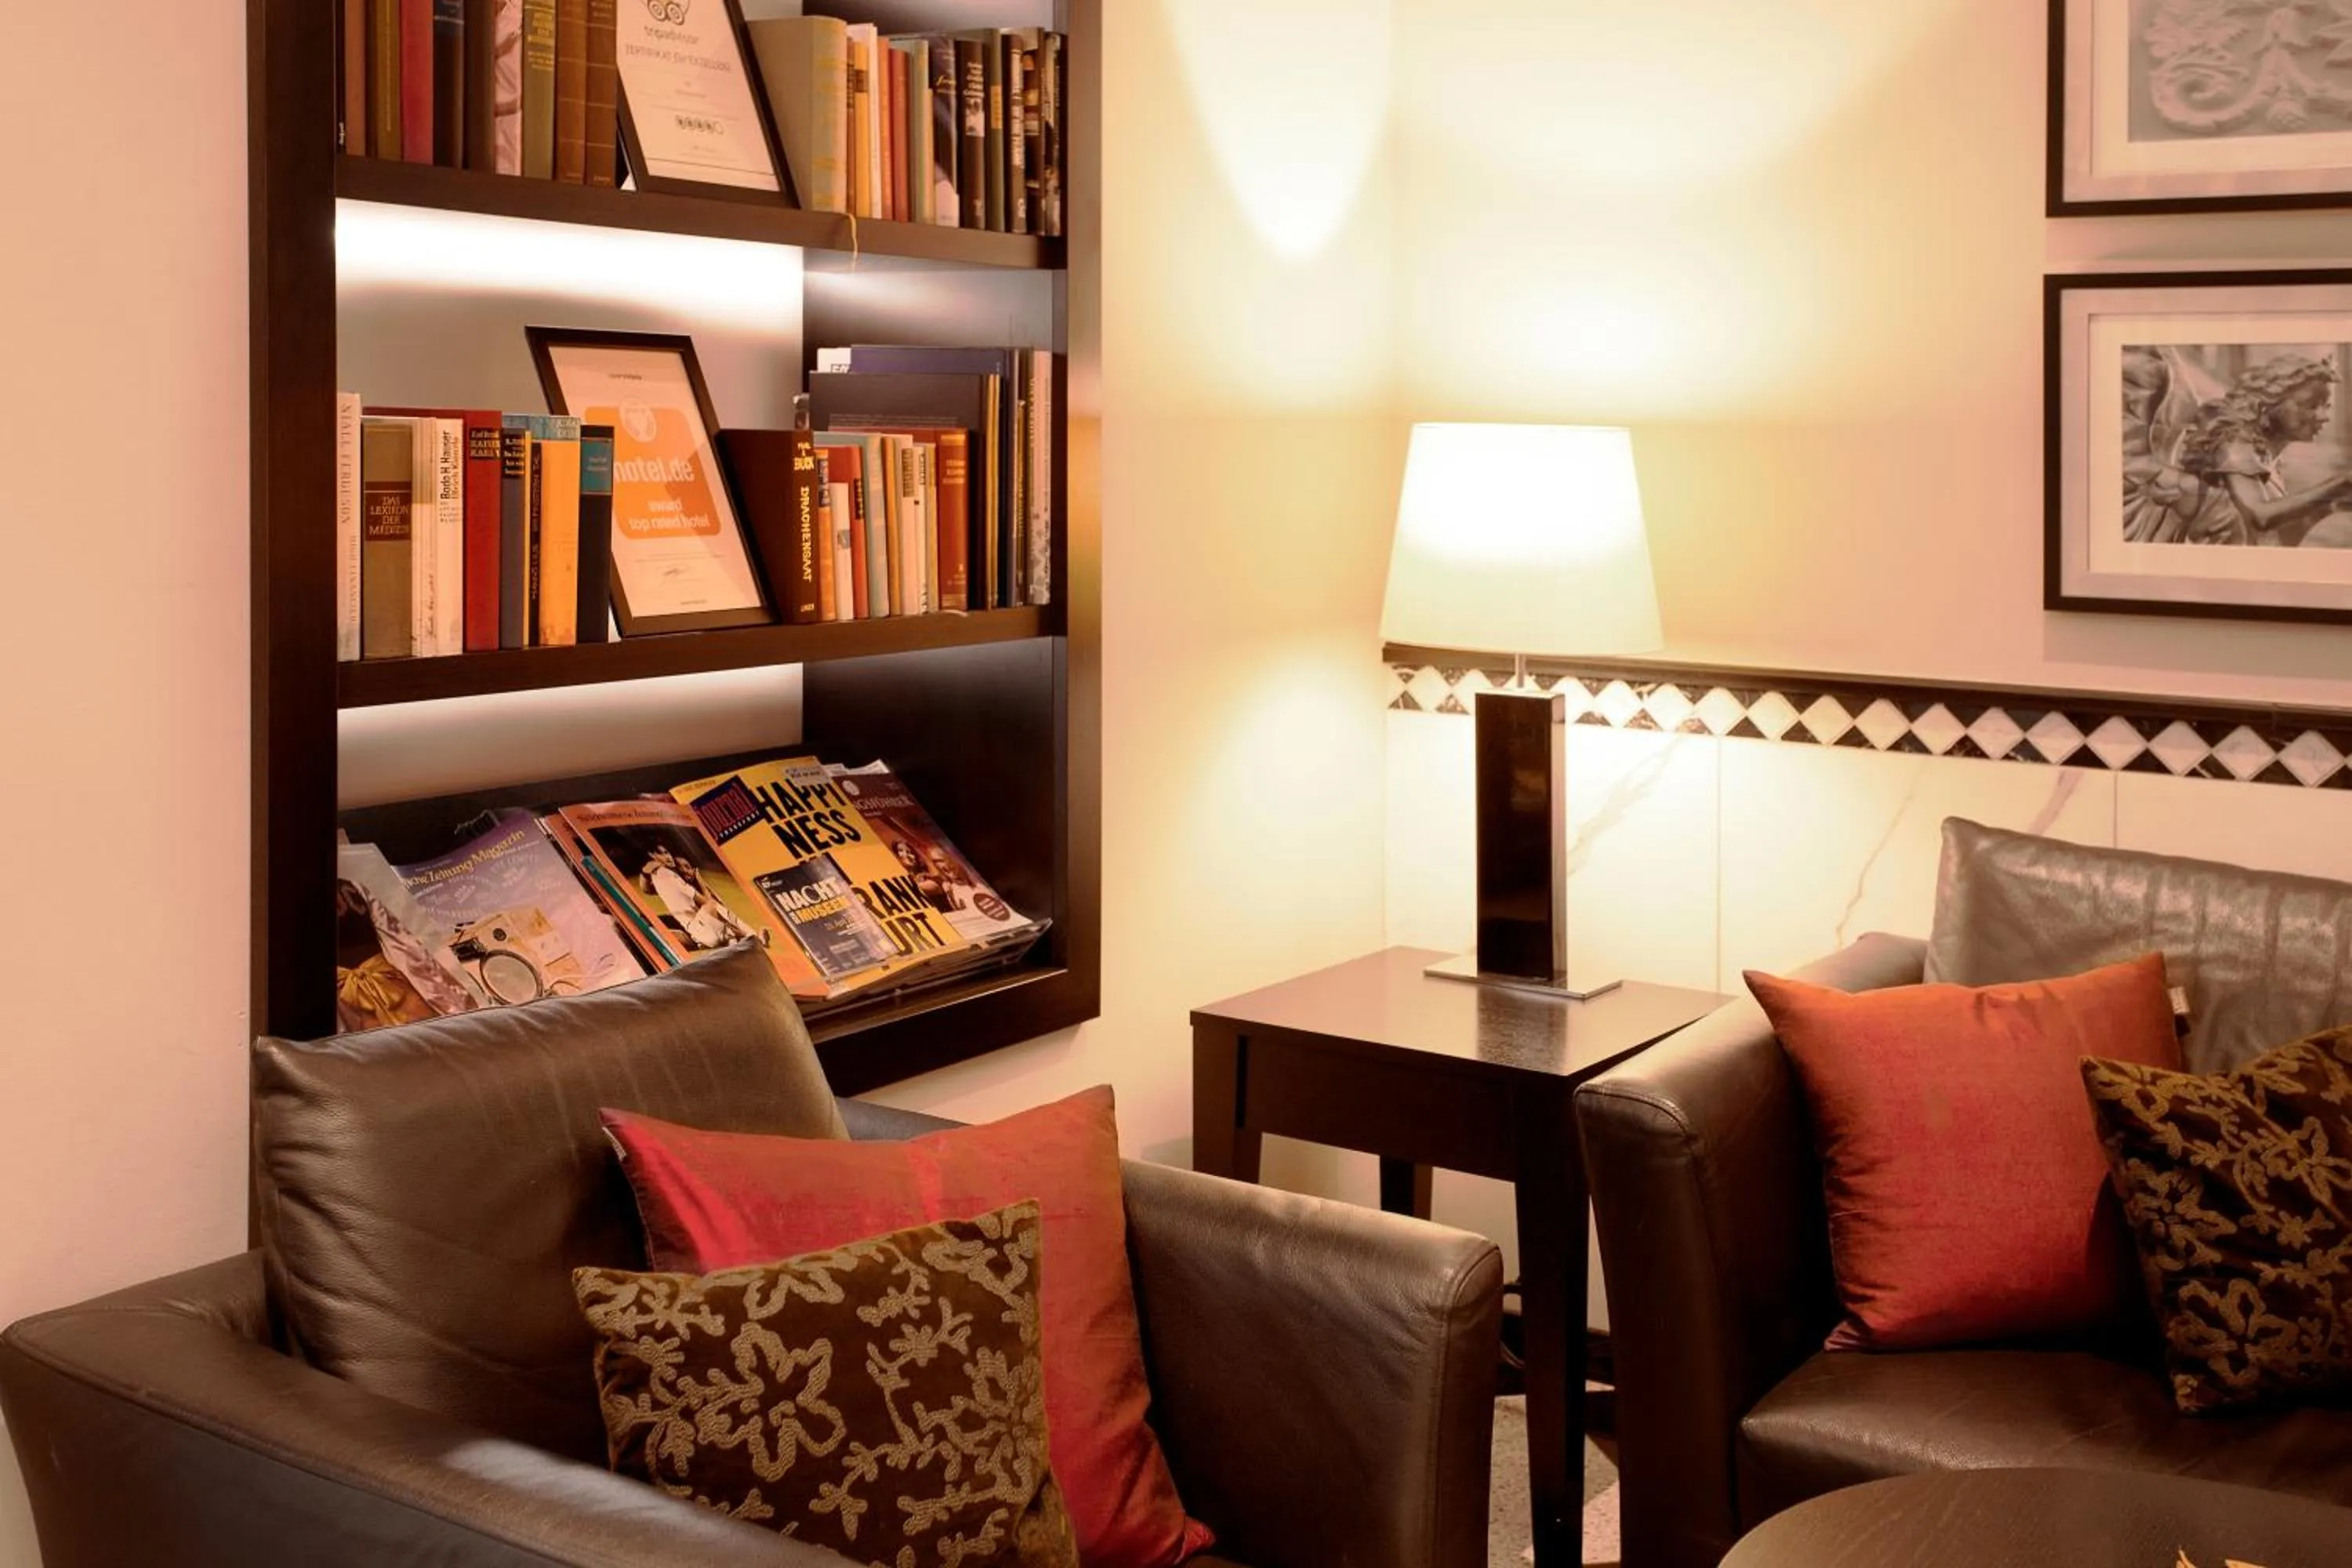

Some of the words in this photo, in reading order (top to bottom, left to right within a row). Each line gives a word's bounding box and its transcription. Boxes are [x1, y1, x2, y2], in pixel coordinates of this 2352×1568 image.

[800, 485, 812, 583] DRACHENSAAT
[771, 809, 861, 859] NESS
[775, 876, 844, 912] NACHT
[851, 874, 931, 920] RANK
[880, 912, 946, 956] URT
